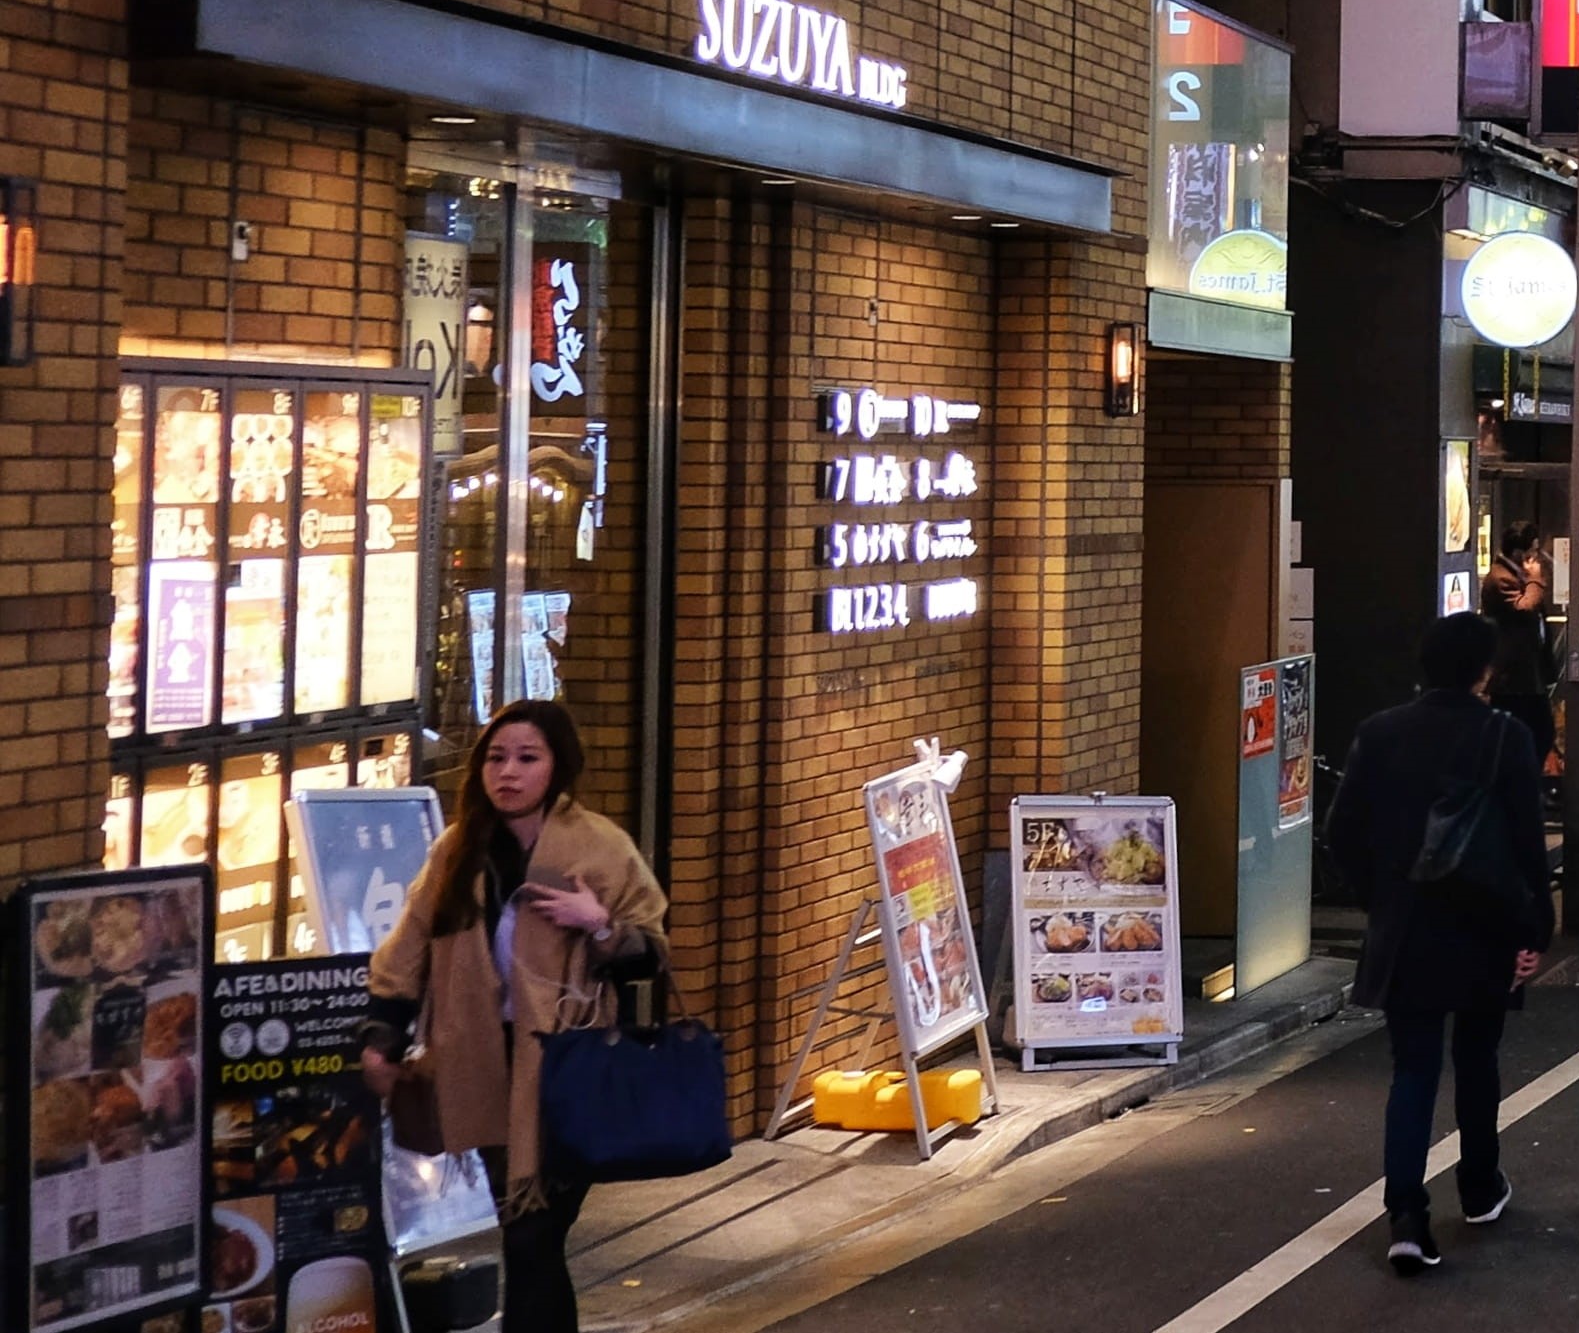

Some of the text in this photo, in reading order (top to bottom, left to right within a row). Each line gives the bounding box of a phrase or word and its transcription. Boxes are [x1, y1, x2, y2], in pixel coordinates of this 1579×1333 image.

[859, 57, 908, 110] BLDG
[219, 1001, 265, 1019] OPEN
[326, 992, 370, 1010] 24:00
[220, 1059, 285, 1085] FOOD
